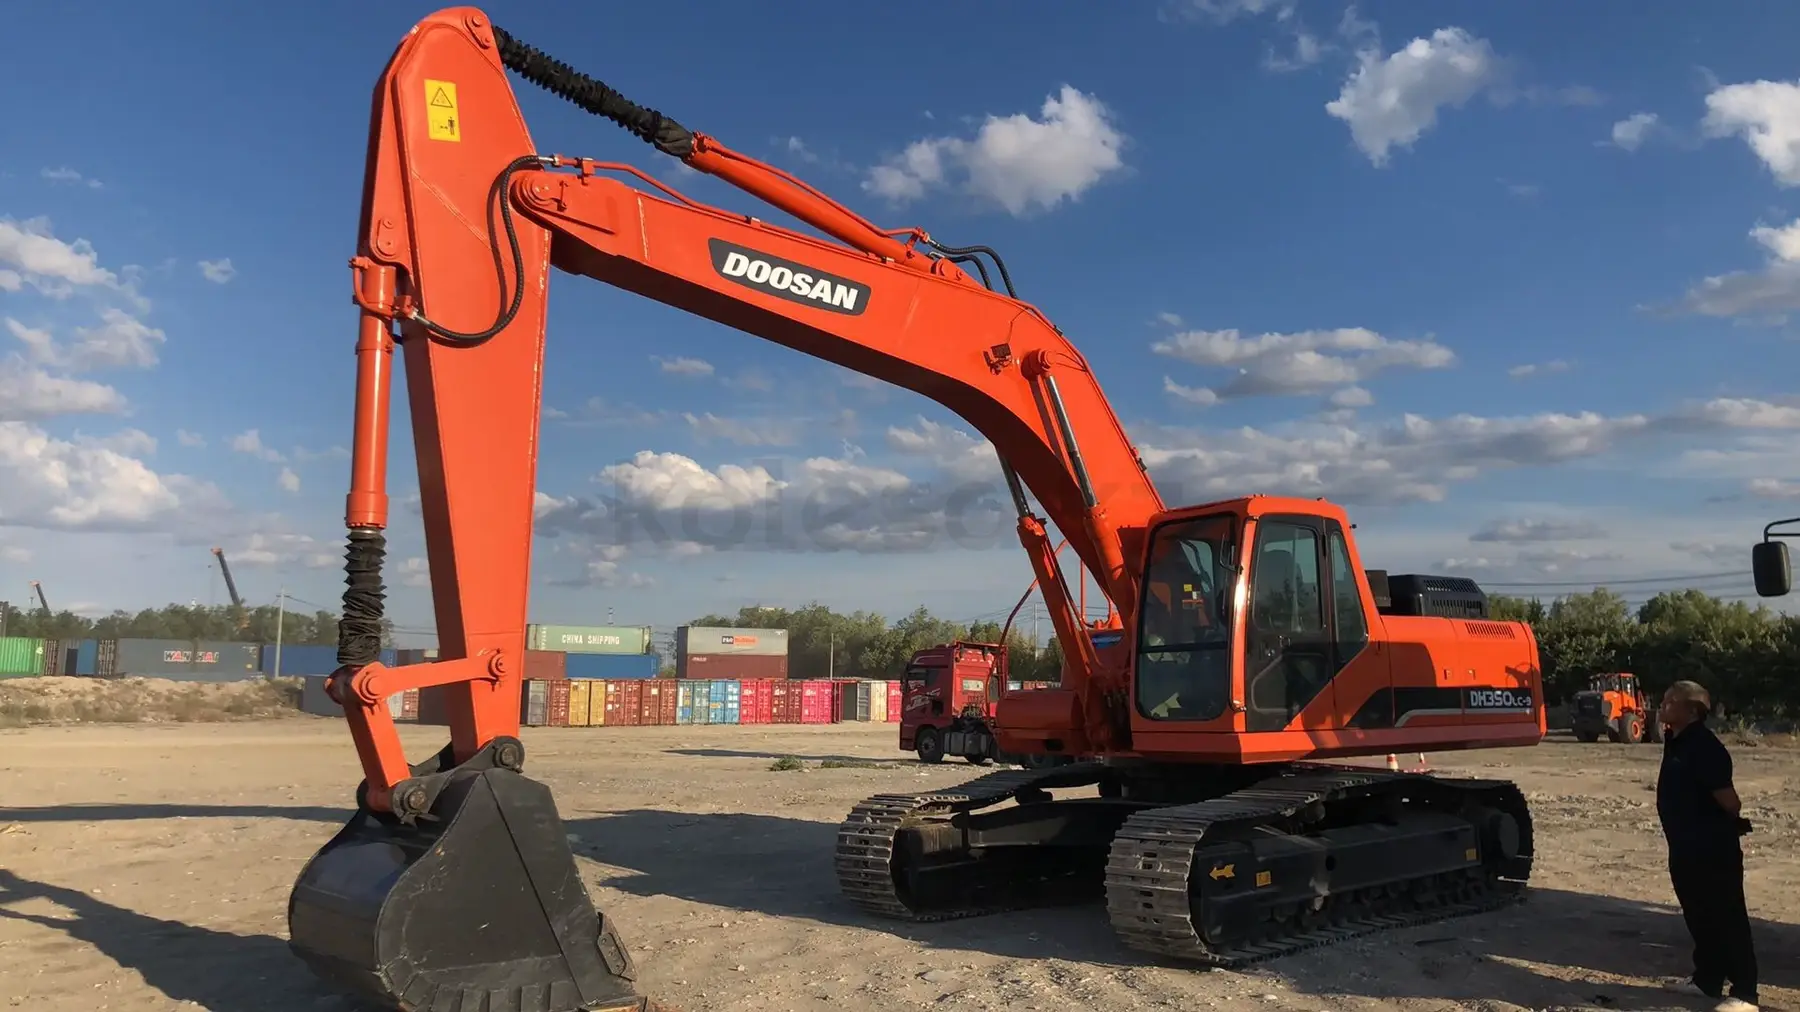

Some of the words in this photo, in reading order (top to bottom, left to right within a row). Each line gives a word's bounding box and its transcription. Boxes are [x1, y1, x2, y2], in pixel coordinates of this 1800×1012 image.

[722, 252, 858, 310] DOOSAN
[562, 634, 583, 644] CHINA
[587, 635, 620, 645] SHIPPING
[164, 651, 191, 662] WAN
[195, 651, 219, 663] HAI
